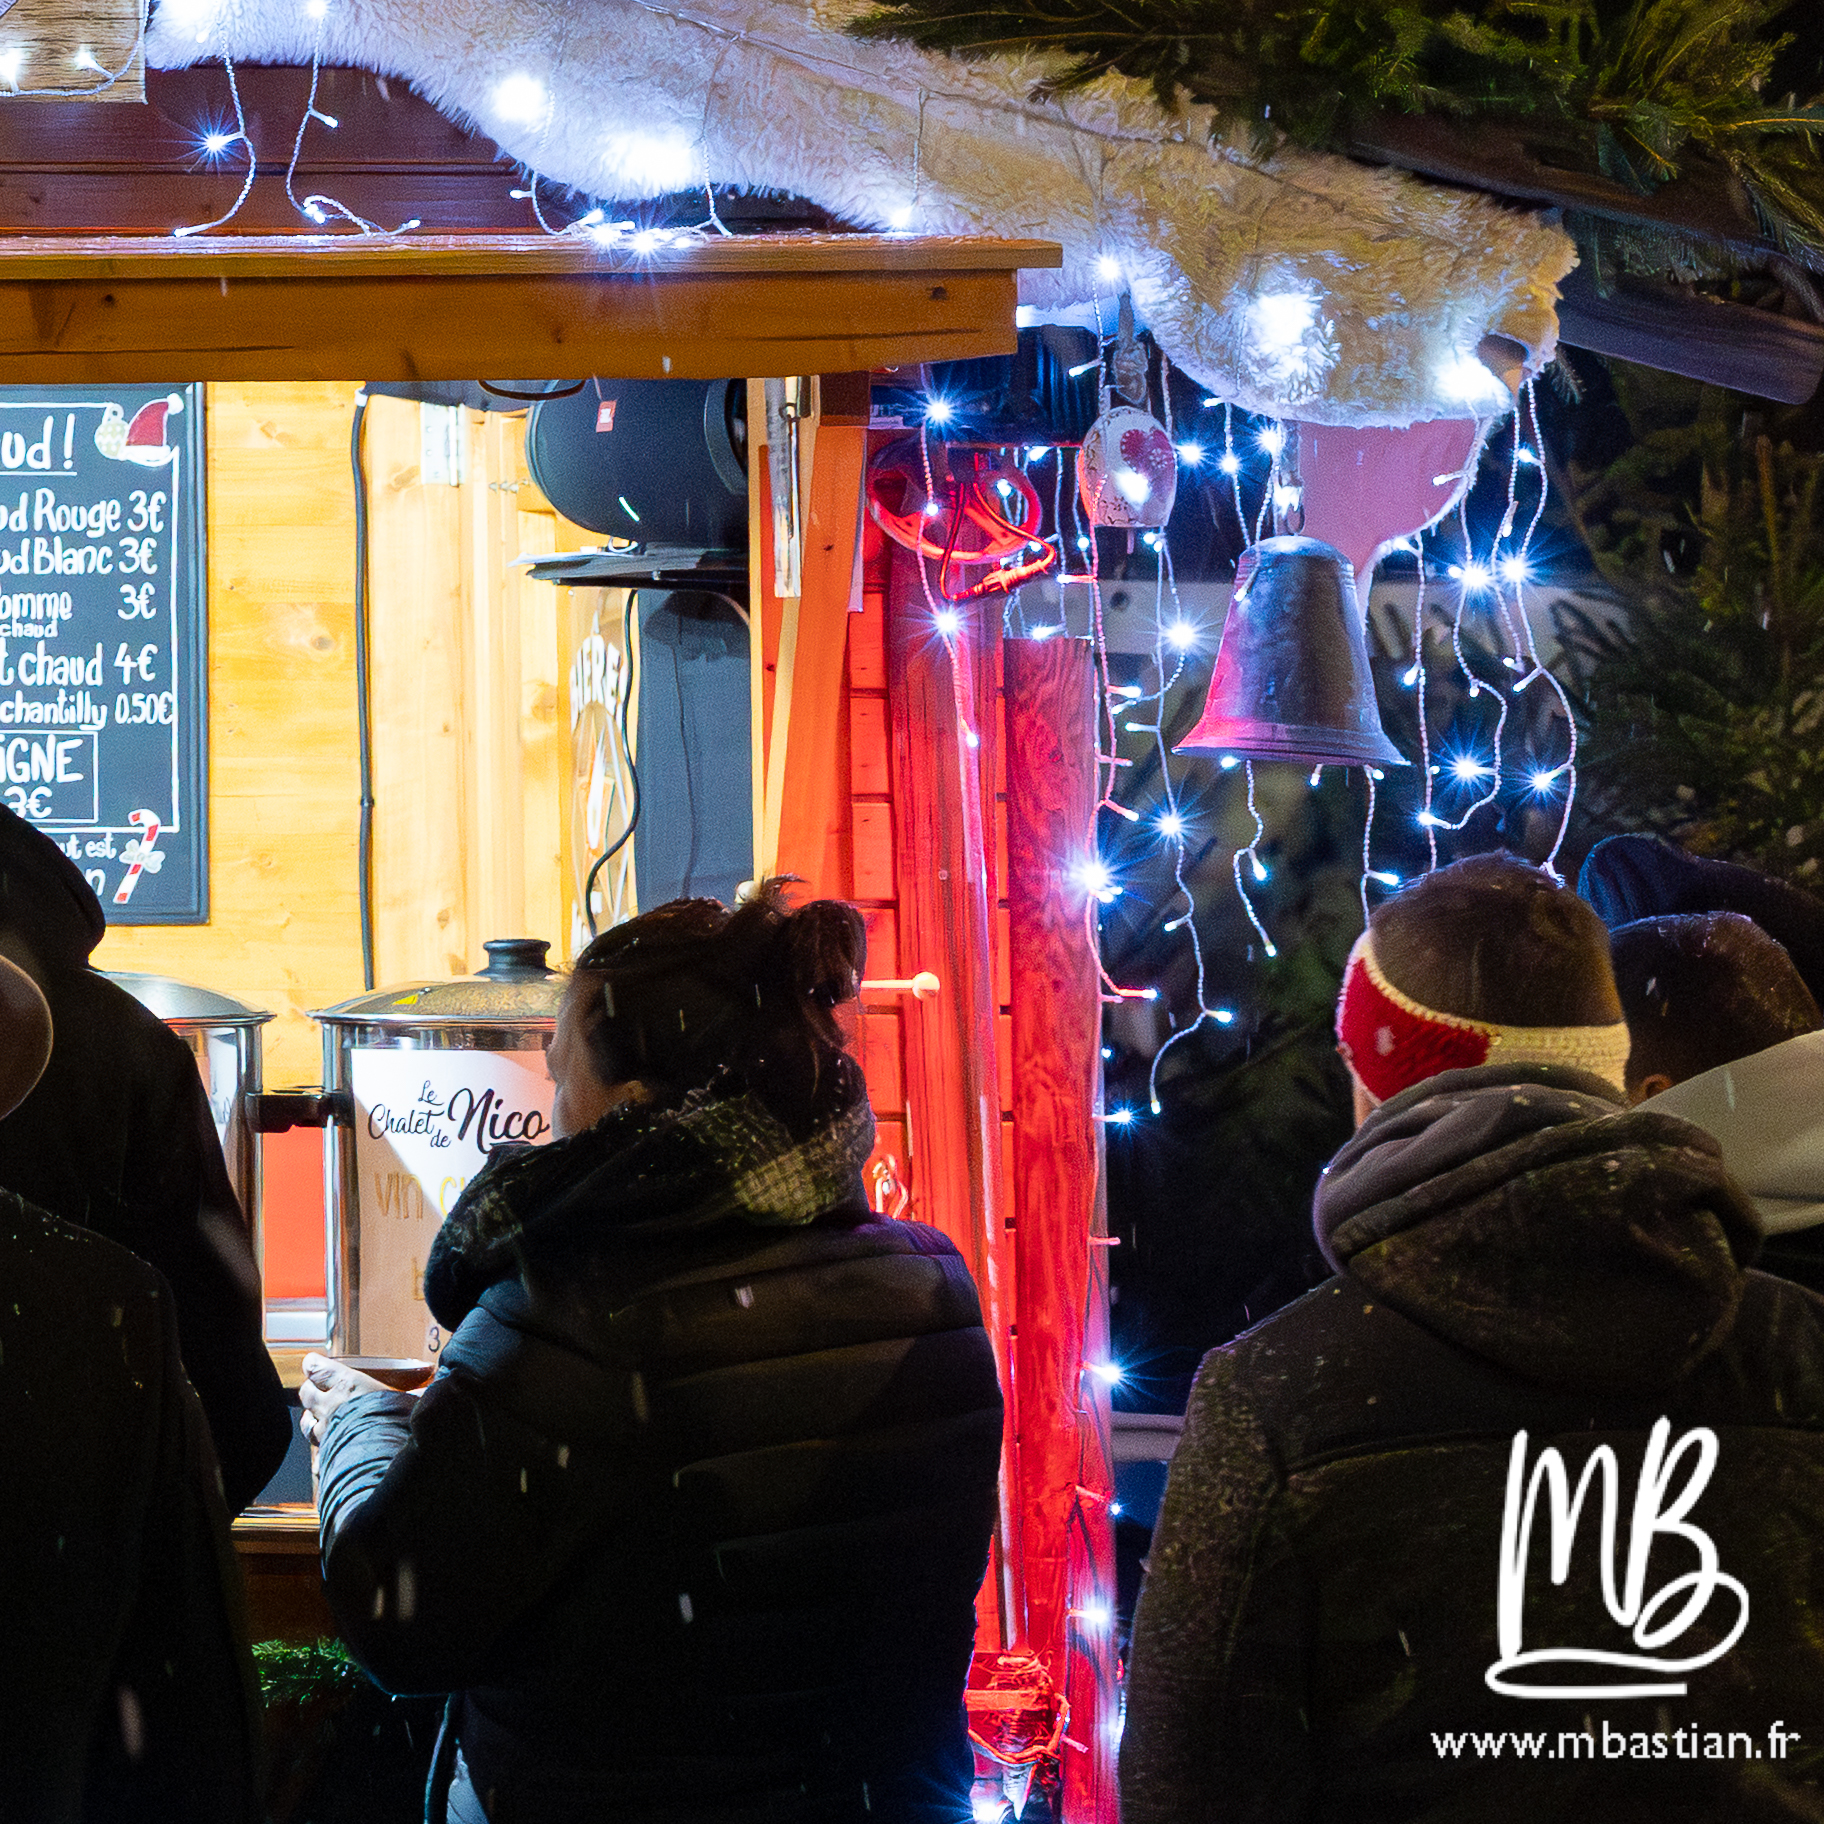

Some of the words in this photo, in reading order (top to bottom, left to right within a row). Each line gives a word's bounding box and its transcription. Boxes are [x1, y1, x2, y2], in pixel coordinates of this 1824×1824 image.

[32, 487, 121, 539] Rouge
[126, 490, 167, 534] 3€
[32, 537, 114, 576] Blanc
[118, 537, 158, 575] 3€
[117, 583, 157, 621] 3€
[17, 640, 103, 687] chaud
[113, 643, 158, 685] 4€
[4, 785, 53, 819] 3€
[85, 832, 117, 860] est
[417, 1079, 446, 1107] Le
[367, 1103, 446, 1140] Chalet
[429, 1128, 452, 1148] de
[448, 1088, 550, 1155] Nico
